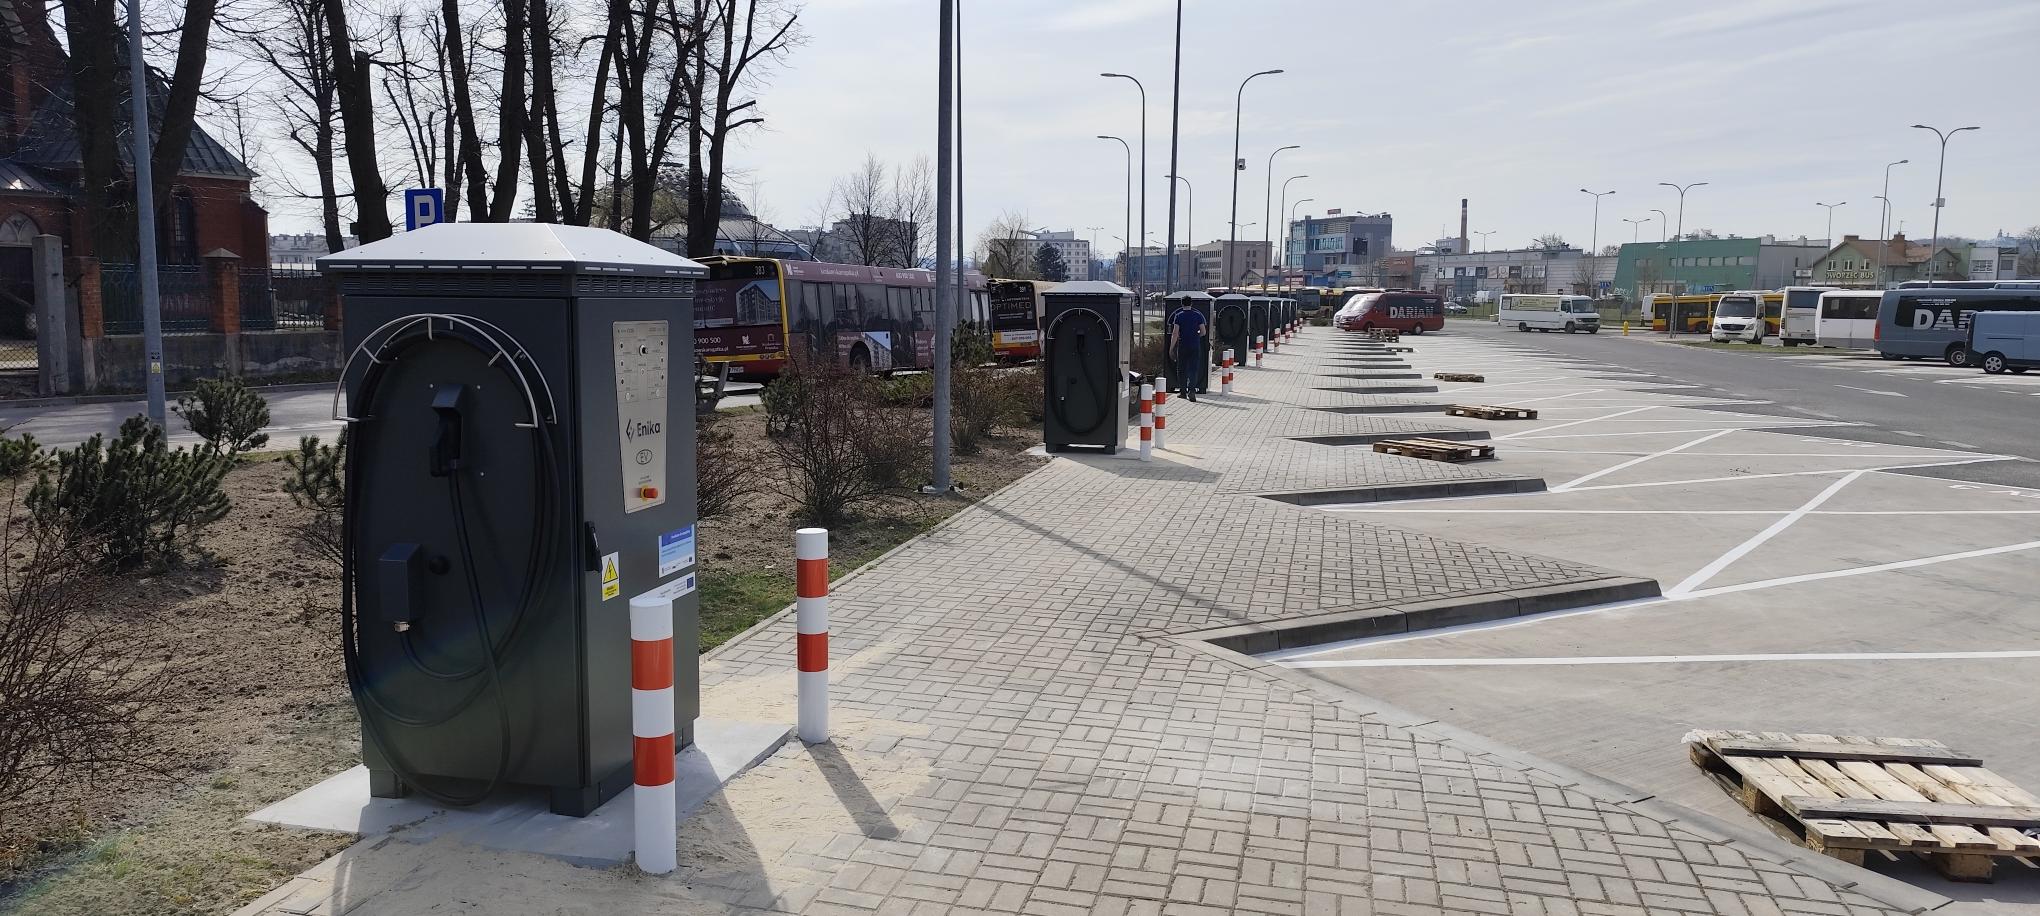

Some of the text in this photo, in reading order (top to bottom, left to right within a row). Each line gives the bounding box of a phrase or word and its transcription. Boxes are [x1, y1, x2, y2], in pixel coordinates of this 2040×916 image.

[413, 194, 436, 229] P
[1860, 271, 1874, 279] BUS
[710, 336, 721, 344] 500
[637, 421, 661, 437] Enika
[640, 451, 649, 462] EV
